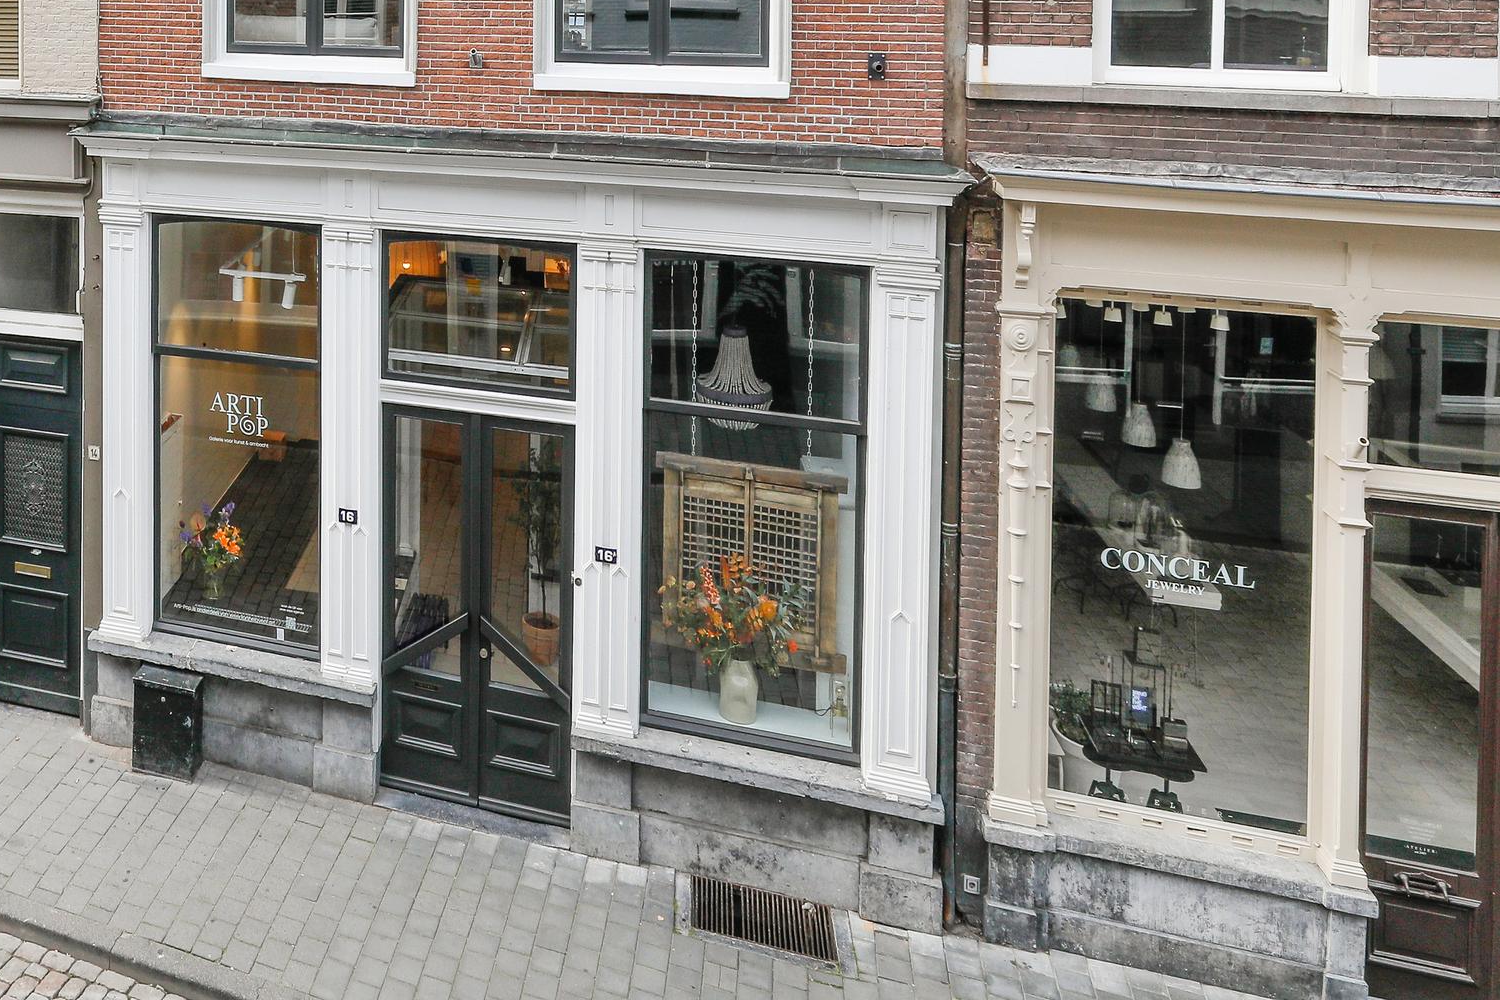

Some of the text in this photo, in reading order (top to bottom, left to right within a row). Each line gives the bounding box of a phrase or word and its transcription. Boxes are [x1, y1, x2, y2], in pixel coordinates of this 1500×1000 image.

[209, 391, 263, 417] ARTI
[226, 413, 269, 437] POP
[90, 448, 98, 457] 14
[340, 510, 354, 522] 16
[1100, 547, 1255, 590] CONCEAL
[1144, 579, 1206, 596] JEWELRY
